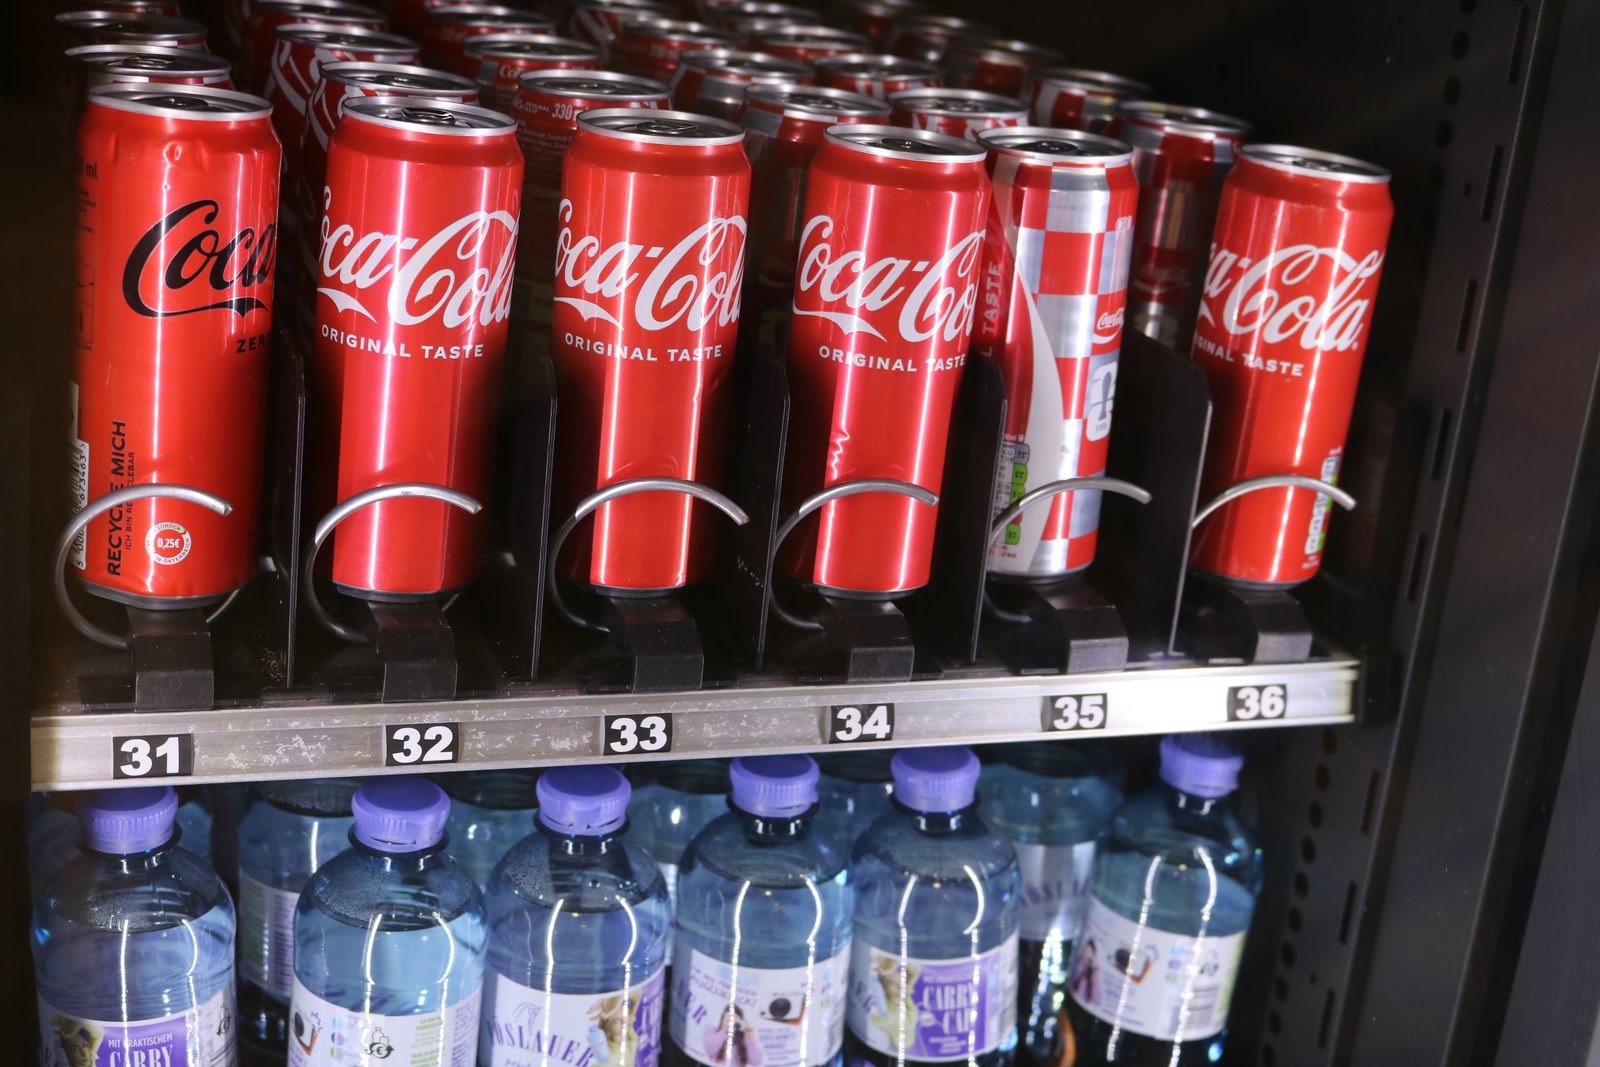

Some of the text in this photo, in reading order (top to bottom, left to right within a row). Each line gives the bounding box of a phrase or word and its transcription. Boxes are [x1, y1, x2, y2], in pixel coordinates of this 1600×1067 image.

[551, 102, 574, 122] 330
[321, 324, 484, 359] ORIGINAL TASTE
[564, 332, 722, 362] ORIGINAL TASTE
[818, 345, 966, 372] ORIGINAL TASTE
[1242, 352, 1305, 377] TASTE
[111, 420, 127, 477] MICH
[126, 516, 134, 532] BIN
[125, 535, 133, 551] ICH
[157, 537, 181, 550] 0,25€
[1053, 695, 1105, 731] 35
[1236, 685, 1285, 720] 36
[609, 716, 668, 753] 33
[835, 705, 891, 741] 34
[119, 737, 182, 776] 31
[392, 723, 454, 764] 32
[108, 1039, 121, 1048] MIT
